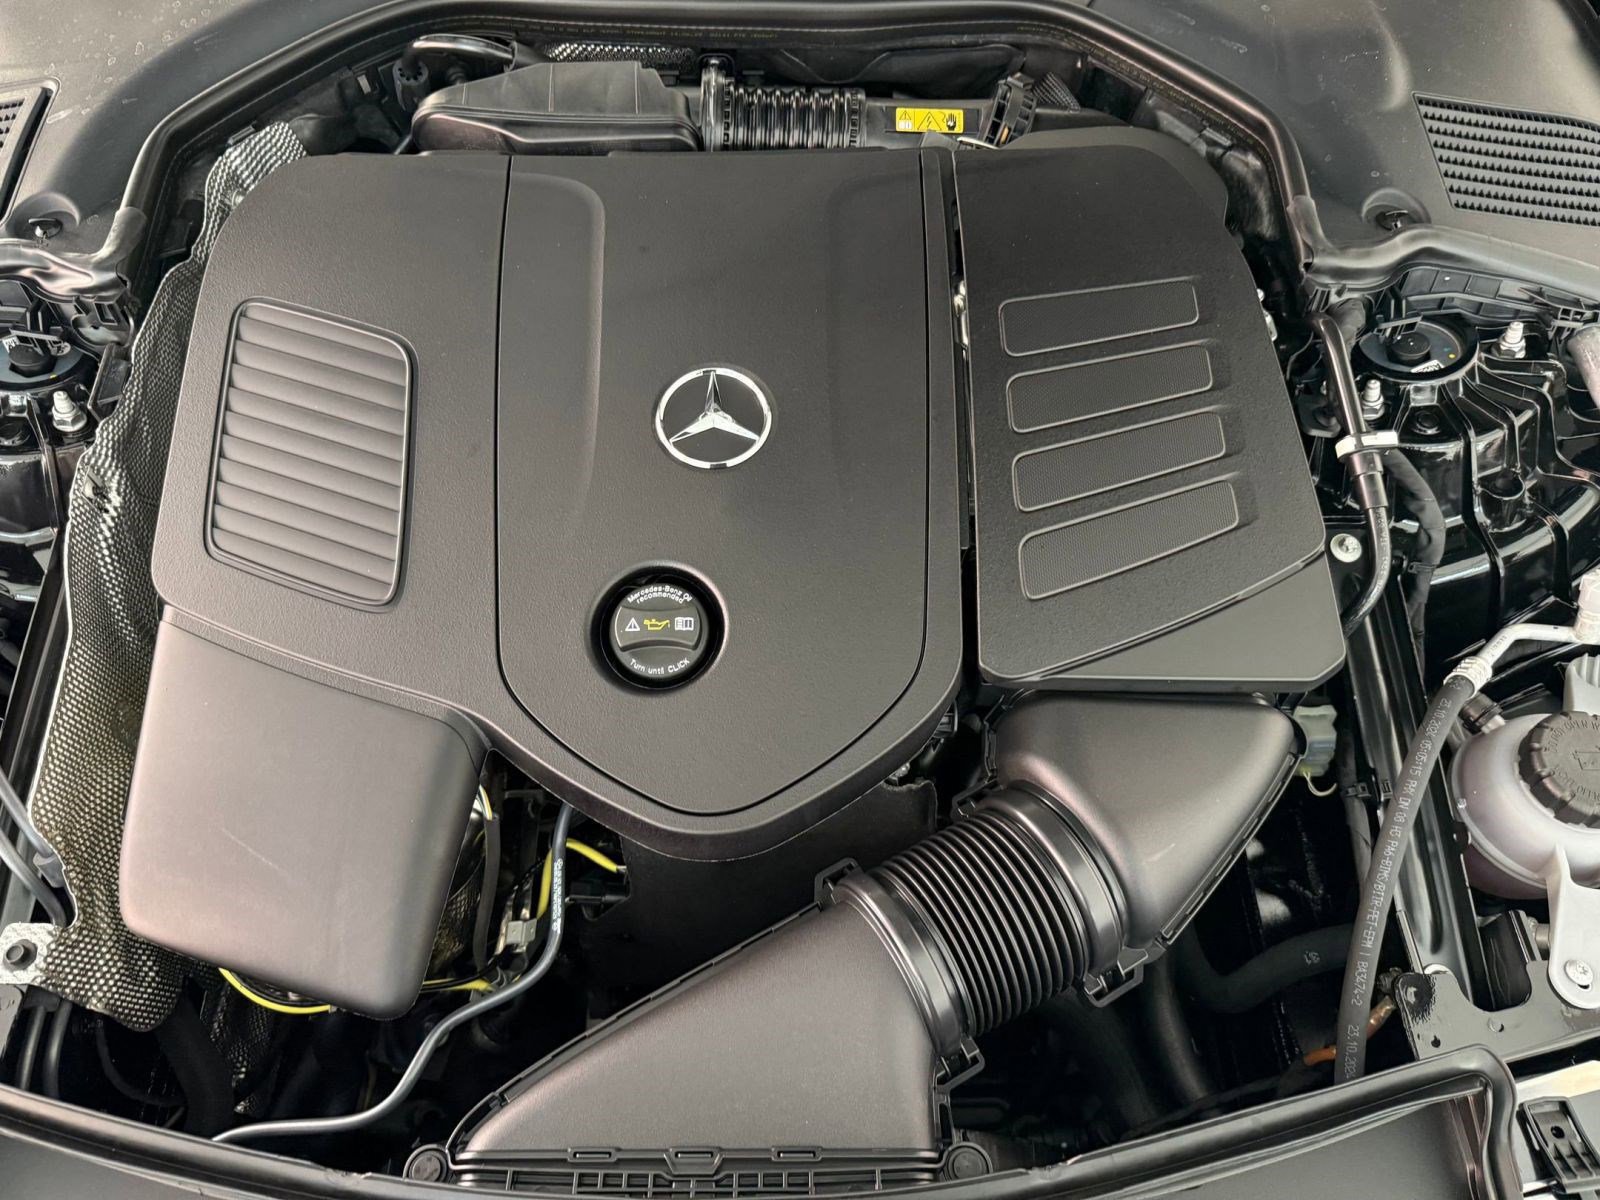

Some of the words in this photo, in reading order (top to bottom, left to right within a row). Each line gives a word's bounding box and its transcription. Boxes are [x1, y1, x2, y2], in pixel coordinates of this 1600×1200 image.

[627, 585, 683, 603] Mercedes-Benz
[636, 592, 684, 604] recommended
[630, 657, 646, 672] Turn
[647, 666, 665, 675] until
[667, 657, 690, 673] CLICK
[1410, 739, 1432, 776] 05:05:15
[1351, 960, 1369, 1006] BA3474-2
